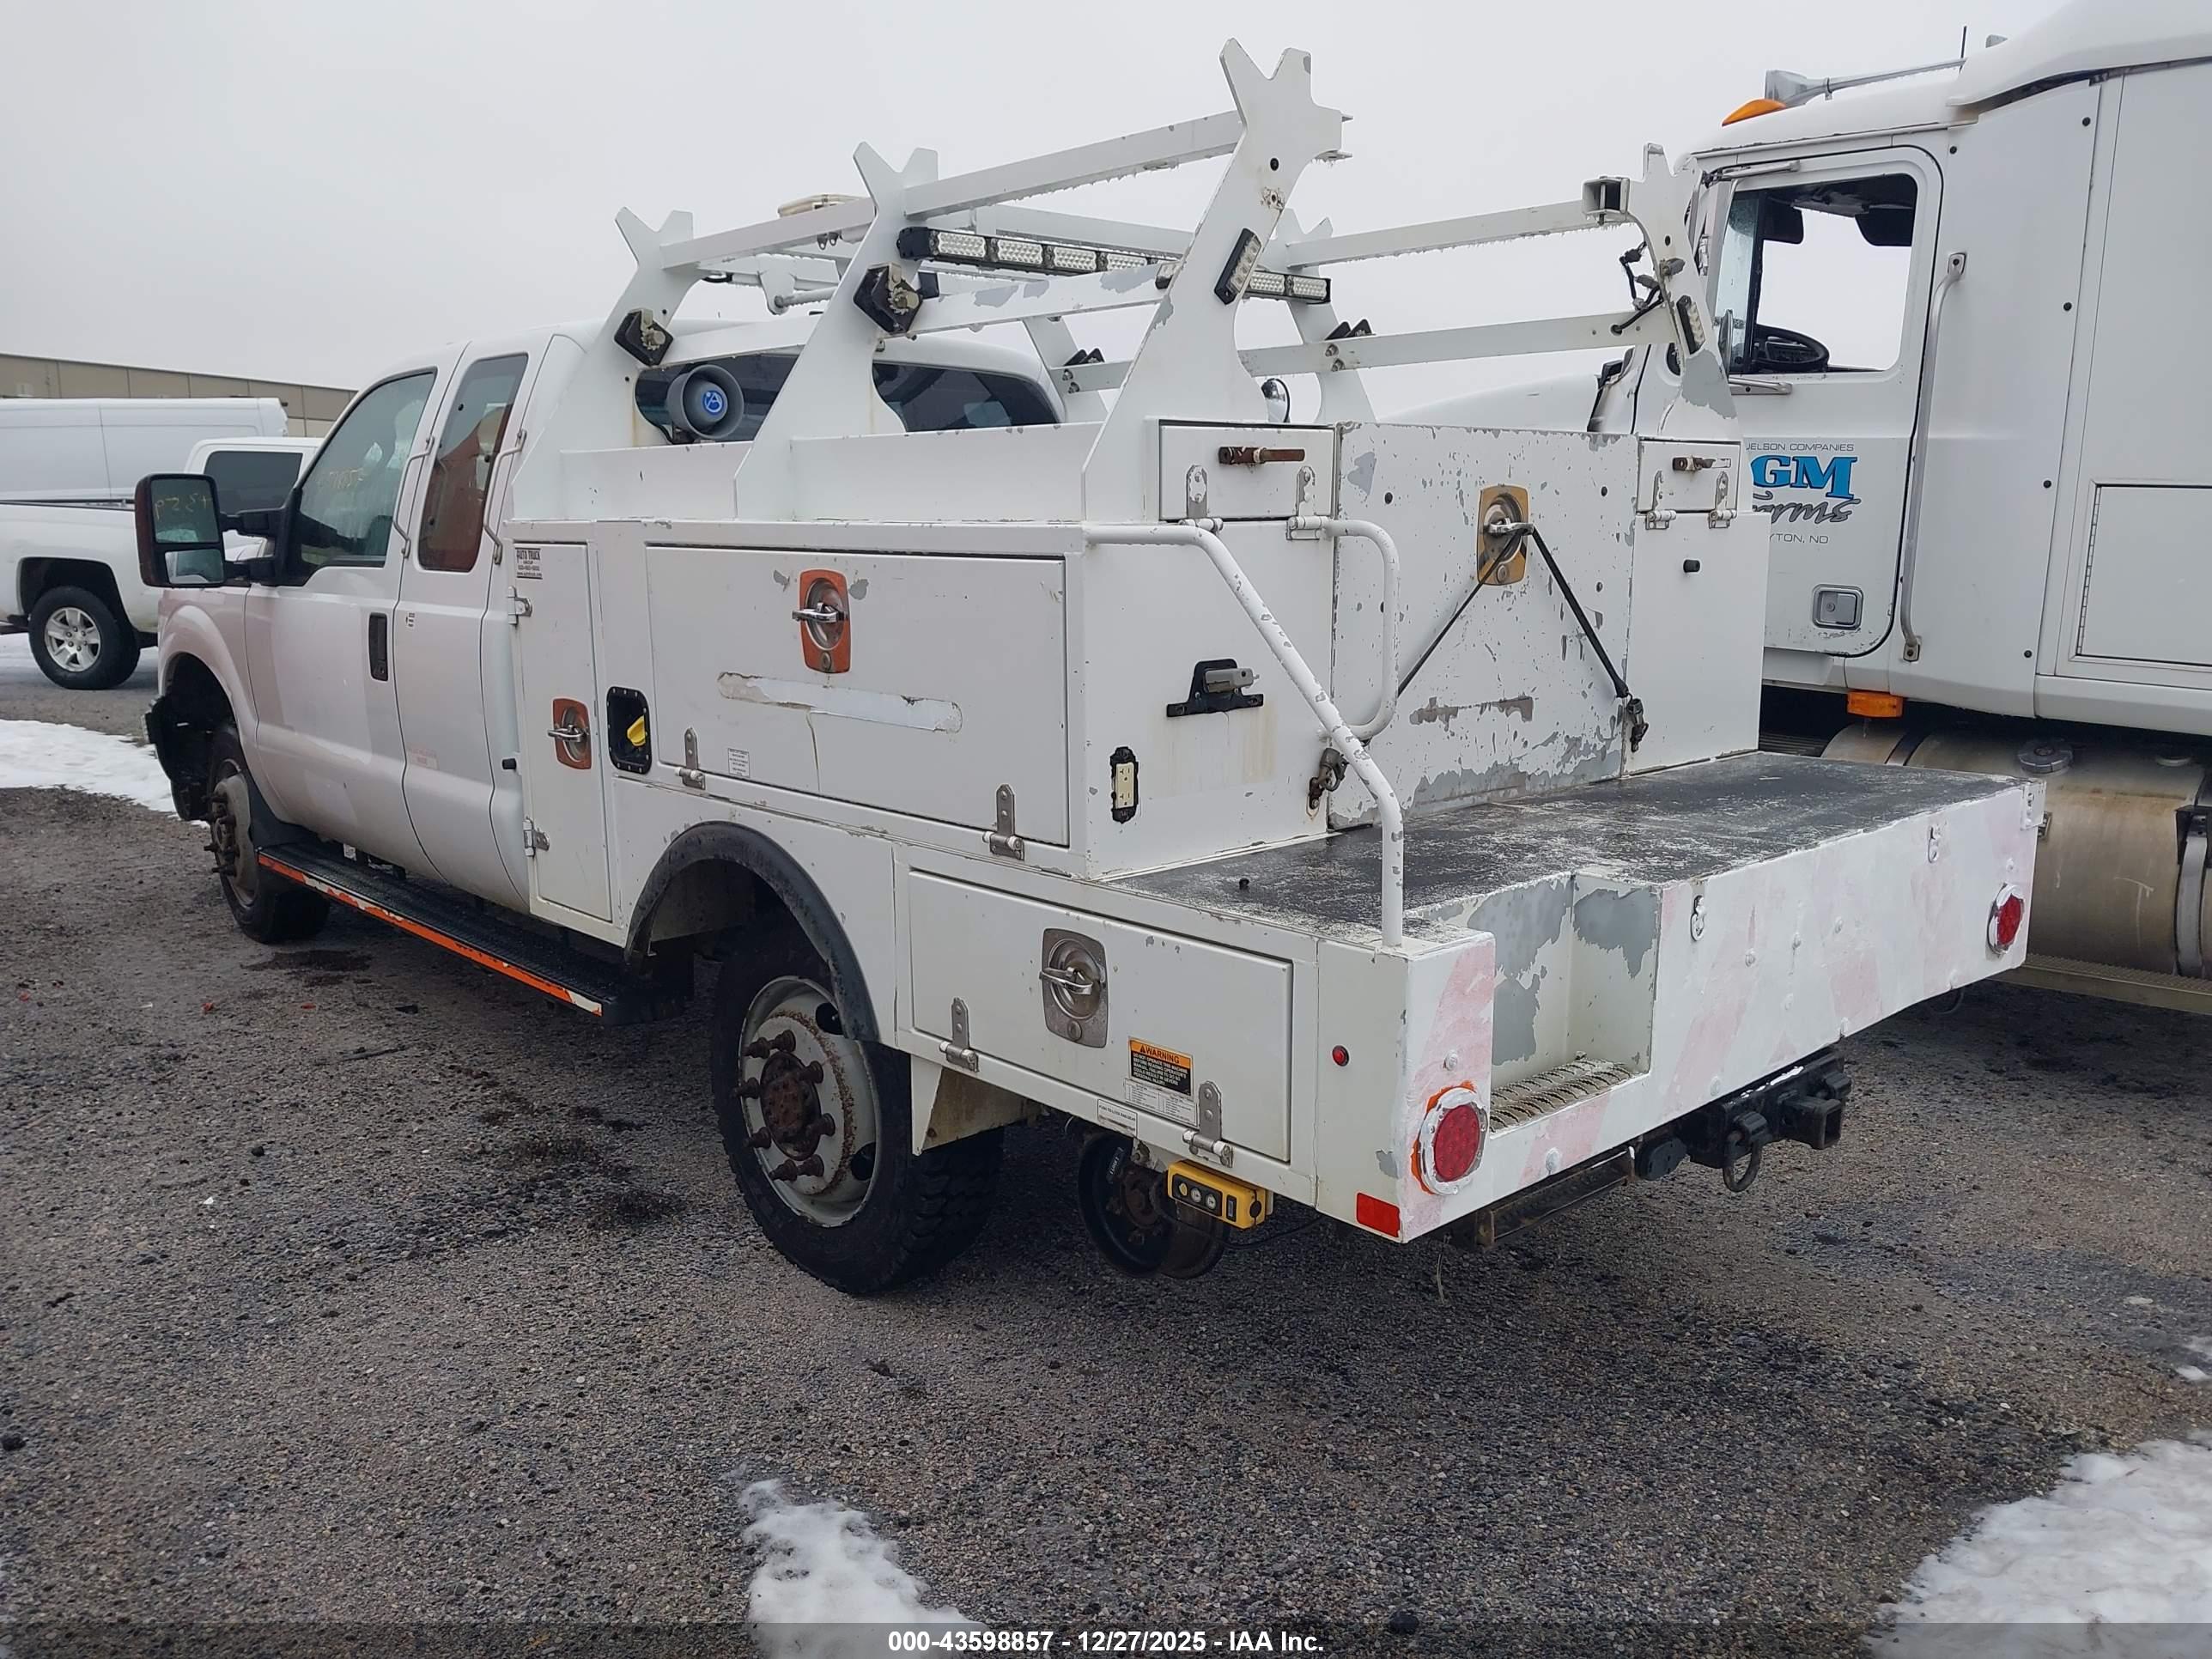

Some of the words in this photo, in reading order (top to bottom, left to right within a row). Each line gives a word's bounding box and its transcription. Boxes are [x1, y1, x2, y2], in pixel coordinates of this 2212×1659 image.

[1790, 443, 1855, 452] COMPANIES
[1809, 535, 1829, 544] ND
[1146, 1044, 1180, 1064] WARNING
